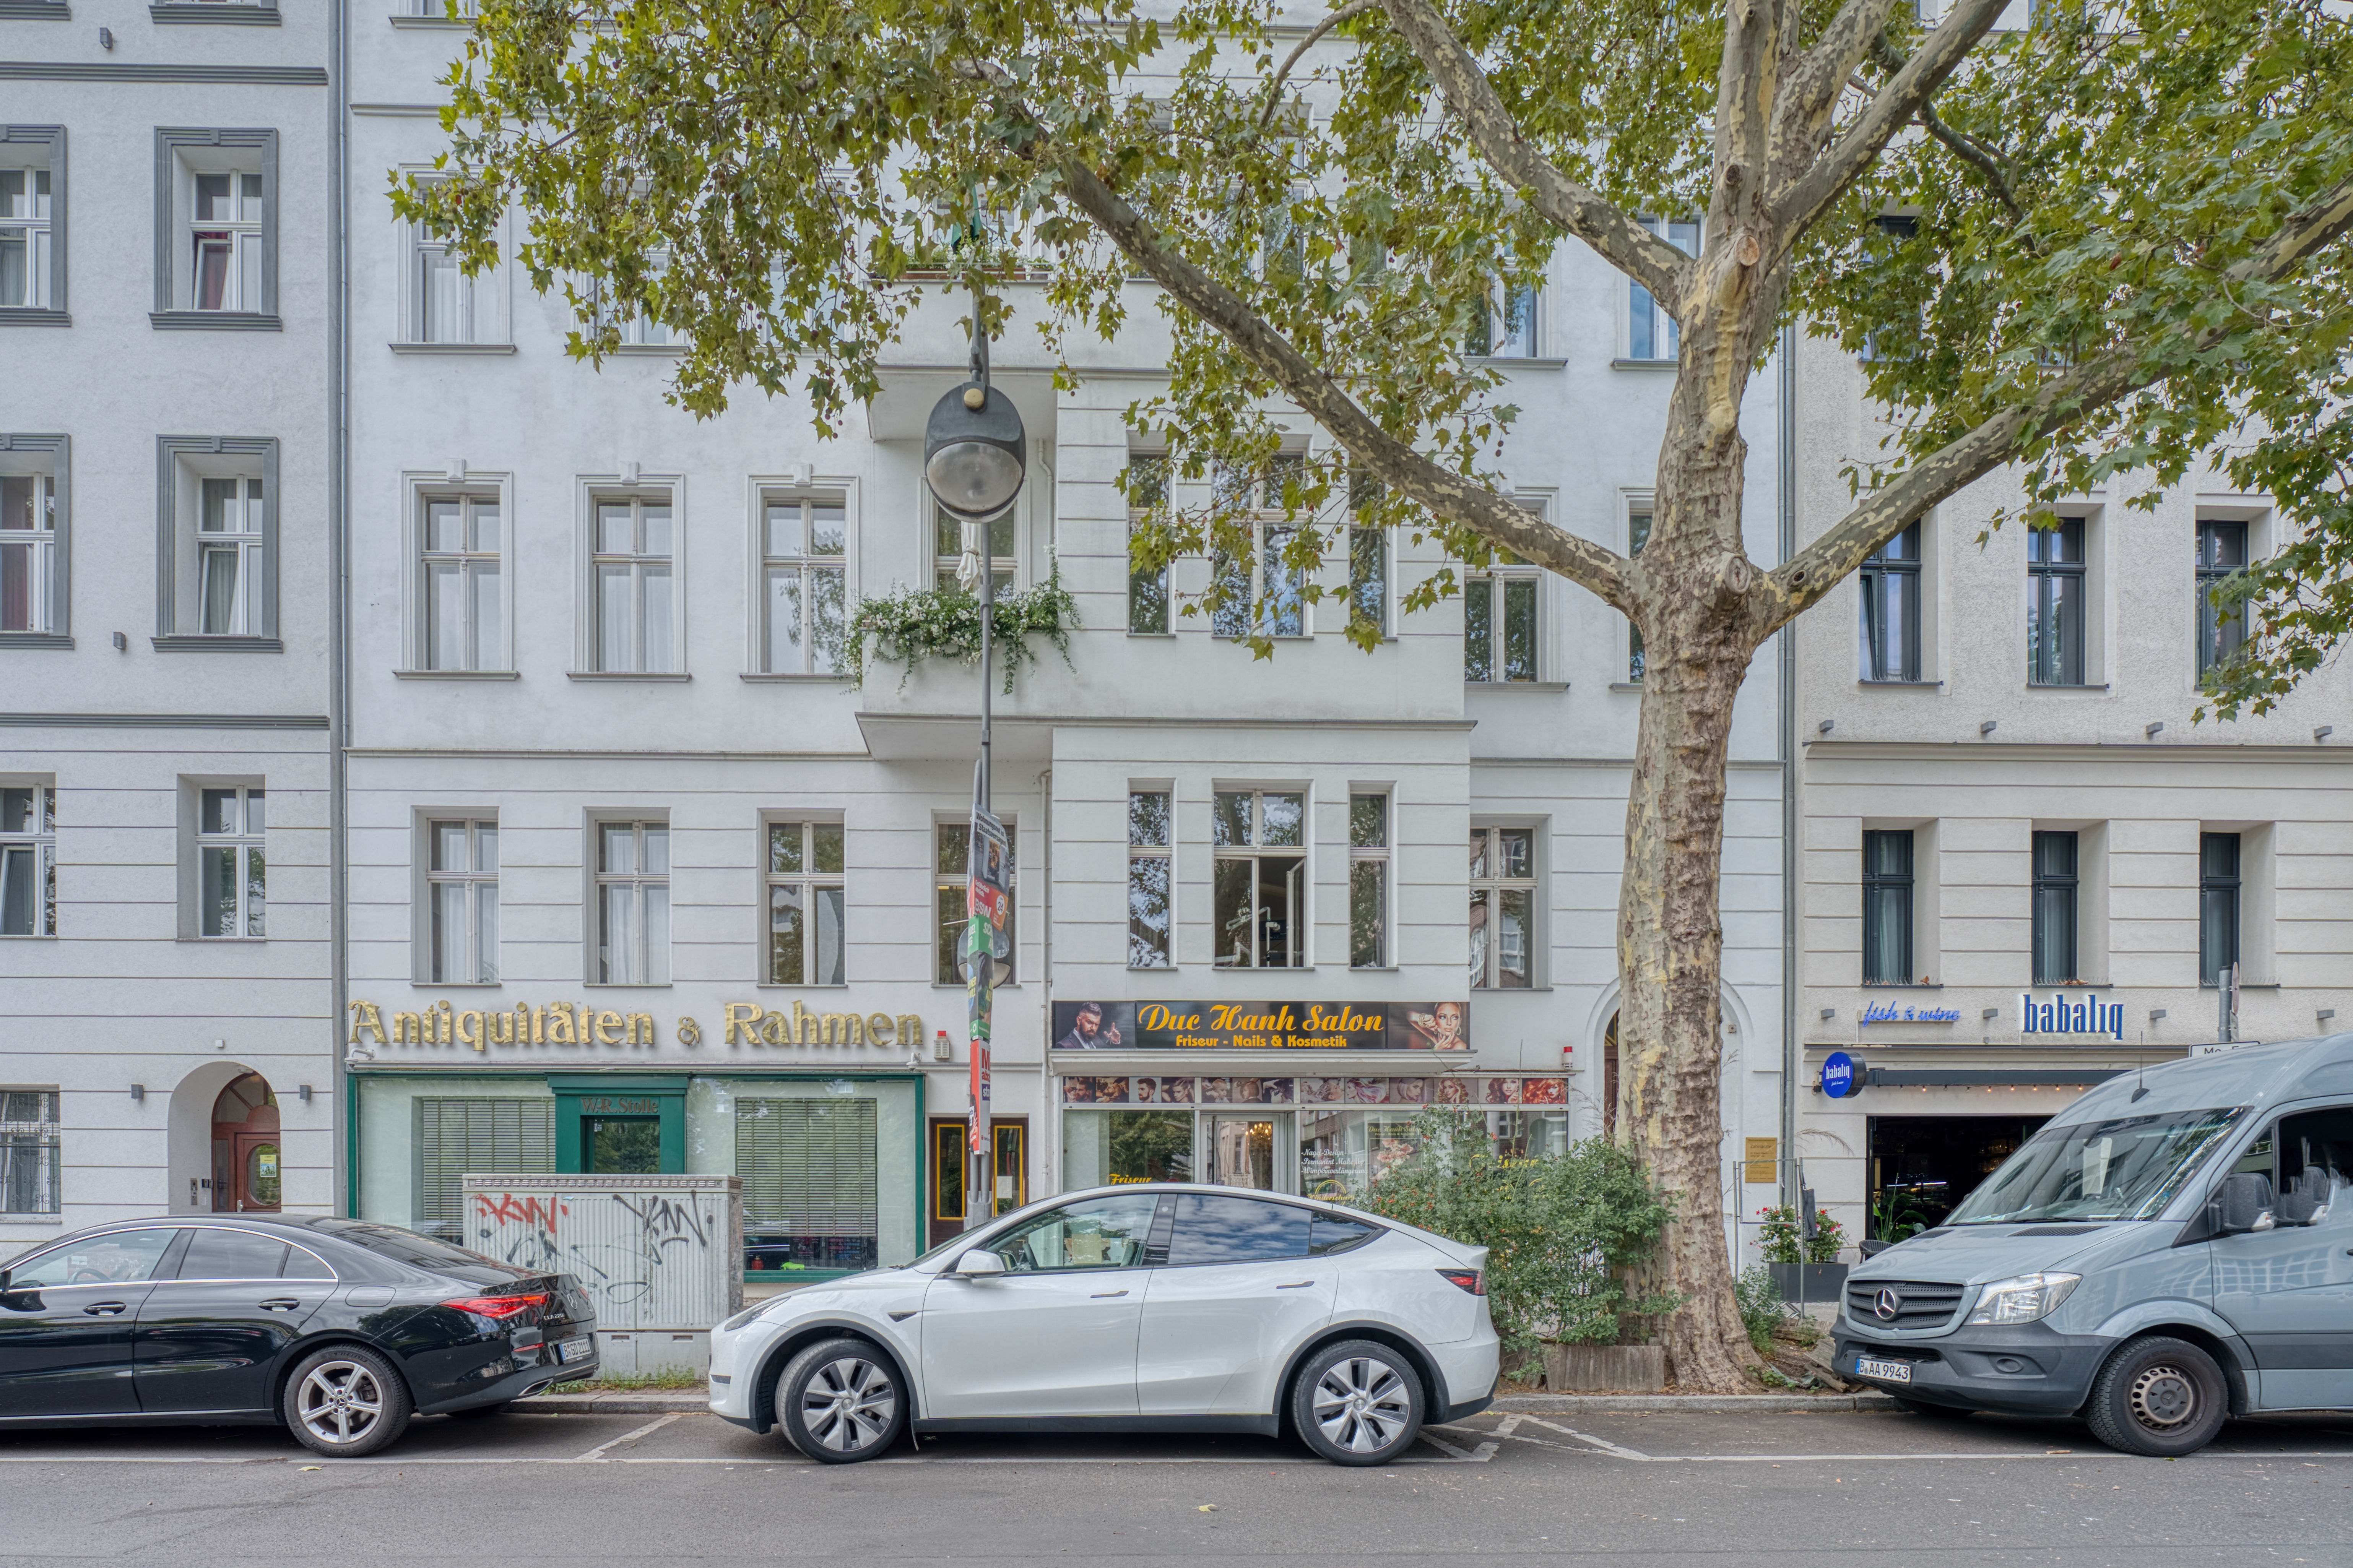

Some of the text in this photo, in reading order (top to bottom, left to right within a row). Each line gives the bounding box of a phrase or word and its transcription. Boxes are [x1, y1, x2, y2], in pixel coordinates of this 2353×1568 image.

[976, 812, 1001, 834] Wohnungsnot
[975, 898, 991, 917] BSW
[998, 901, 1003, 912] 24
[1139, 1005, 1384, 1031] Duc Hanh Salon
[1863, 1000, 1960, 1027] fish & wine
[348, 1000, 923, 1051] Antiquitäten & Rahmen
[1176, 1035, 1219, 1047] Friseur
[1233, 1035, 1266, 1047] Nails
[1271, 1035, 1283, 1047] &
[1288, 1035, 1347, 1047] Kosmetik
[619, 1098, 658, 1113] Stolle
[1106, 1174, 1152, 1185] Friseur
[336, 1352, 366, 1362] MICHELIN
[563, 1339, 590, 1358] B GD 2111
[1859, 1360, 1909, 1380] B AA 9943
[2125, 1349, 2170, 1376] NEXEN
[312, 1441, 343, 1454] MICHELIN
